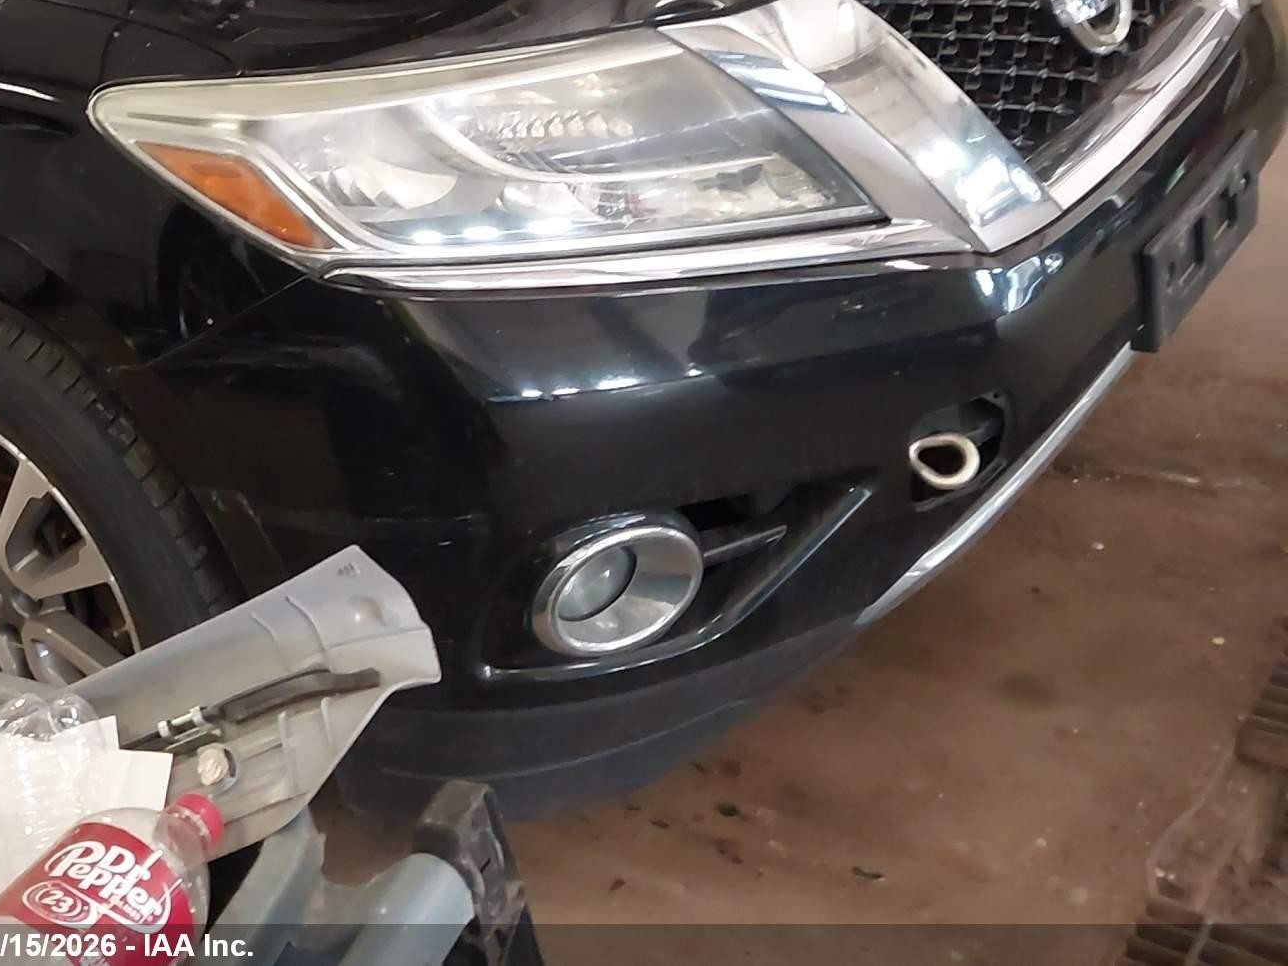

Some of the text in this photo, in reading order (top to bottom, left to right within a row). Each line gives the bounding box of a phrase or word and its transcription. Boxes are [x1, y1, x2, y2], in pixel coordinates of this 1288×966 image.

[44, 841, 183, 916] Pepper
[96, 845, 163, 882] Dr
[41, 890, 74, 914] 23
